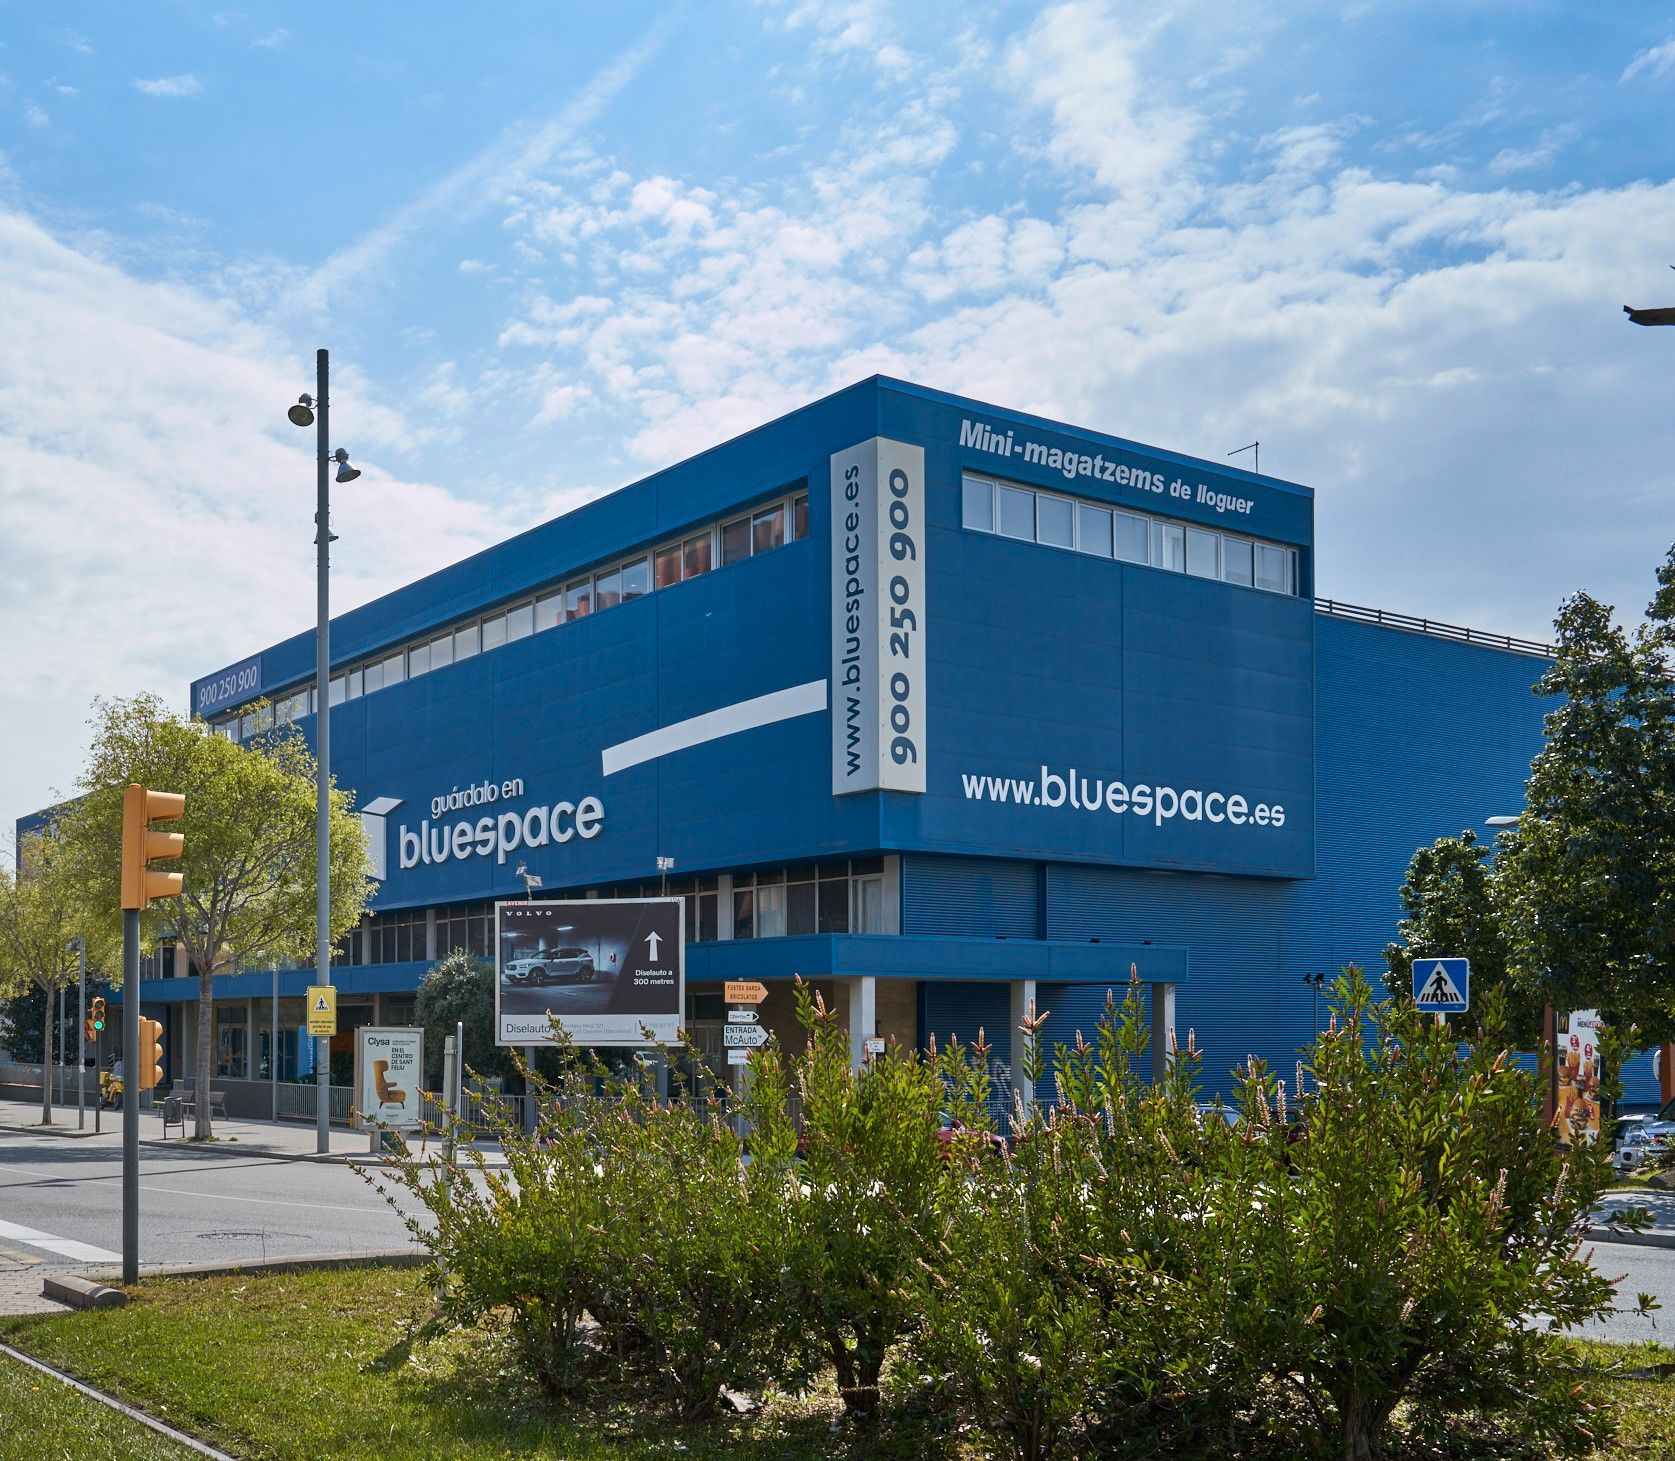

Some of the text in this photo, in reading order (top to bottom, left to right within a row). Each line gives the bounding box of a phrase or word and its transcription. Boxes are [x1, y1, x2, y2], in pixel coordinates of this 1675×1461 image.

[959, 418, 1254, 514] Mini-magatzems de lloguer
[842, 465, 865, 777] www.bluespace.es
[889, 468, 917, 766] 900 250 900
[200, 665, 257, 708] 900 250 900
[431, 778, 524, 819] guárdalo en
[961, 765, 1286, 827] www.bluespace.es
[400, 796, 605, 869] bluespace
[635, 968, 668, 976] Diselauto
[367, 1036, 391, 1046] Clysa
[505, 1022, 551, 1034] Diselauto
[725, 1026, 758, 1034] ENTRADA
